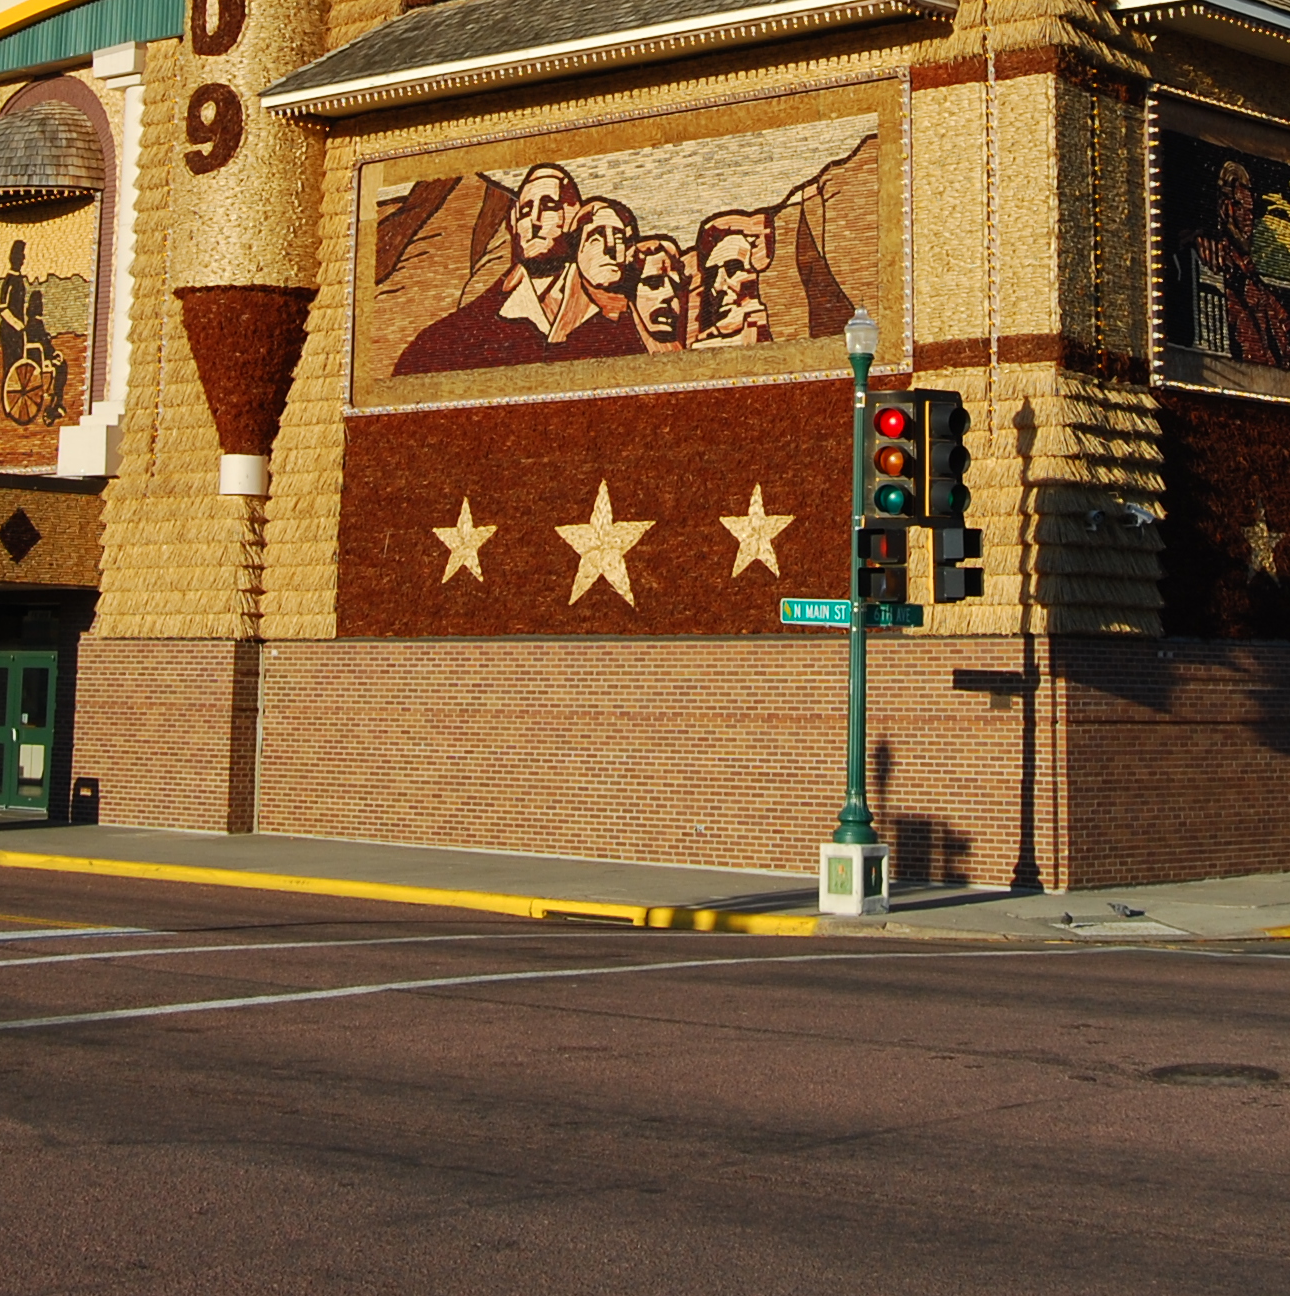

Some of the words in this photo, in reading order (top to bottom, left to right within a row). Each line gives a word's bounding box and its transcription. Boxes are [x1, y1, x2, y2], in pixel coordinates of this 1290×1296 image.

[793, 603, 802, 618] N
[805, 604, 830, 619] MAIN
[834, 605, 847, 620] ST
[873, 606, 893, 622] 6TH
[896, 608, 911, 622] AVE
